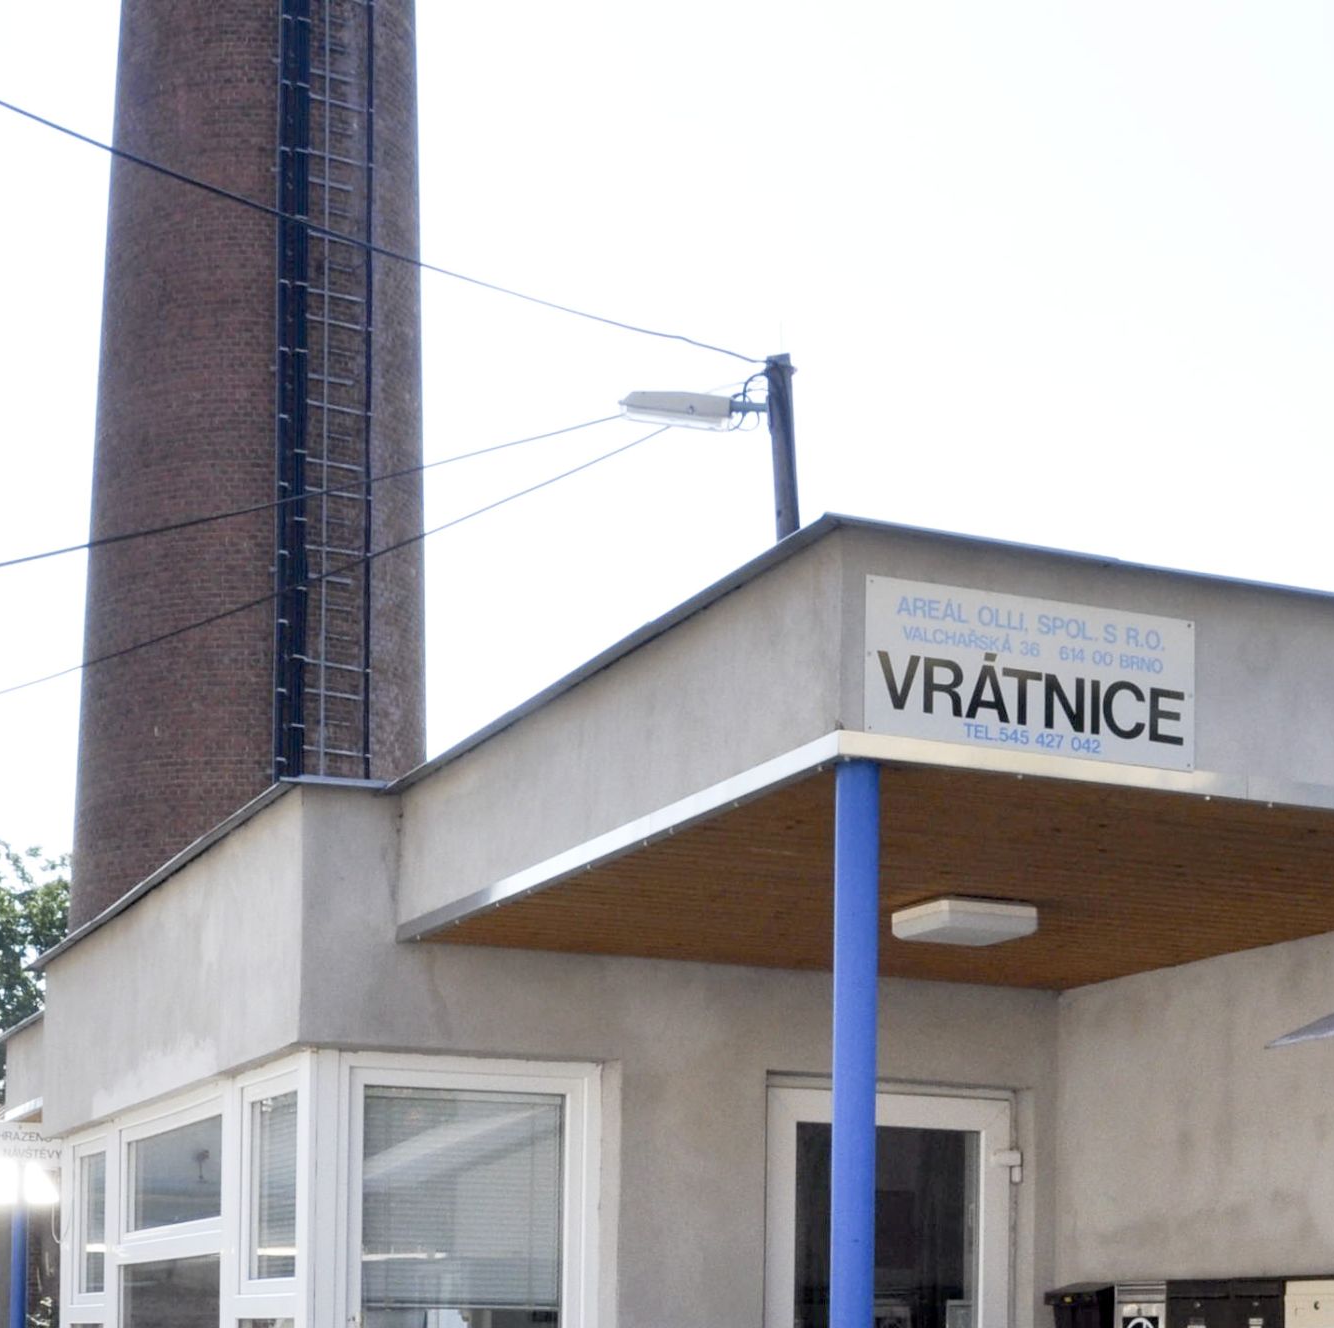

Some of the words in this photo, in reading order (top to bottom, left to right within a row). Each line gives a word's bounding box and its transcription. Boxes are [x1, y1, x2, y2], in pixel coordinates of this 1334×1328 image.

[897, 596, 969, 624] AREÁL
[1037, 614, 1098, 642] SPOL.
[1103, 623, 1118, 644] S
[1126, 627, 1165, 652] R.O.
[902, 625, 1012, 654] VALCHAŘSKÁ
[1019, 641, 1041, 657] 36
[1059, 646, 1085, 663] 614
[1092, 650, 1114, 666] 00
[1119, 653, 1164, 674] BRNO
[877, 650, 1185, 746] VRÁTNICE
[1035, 732, 1064, 749] 427
[1071, 736, 1101, 754] 042
